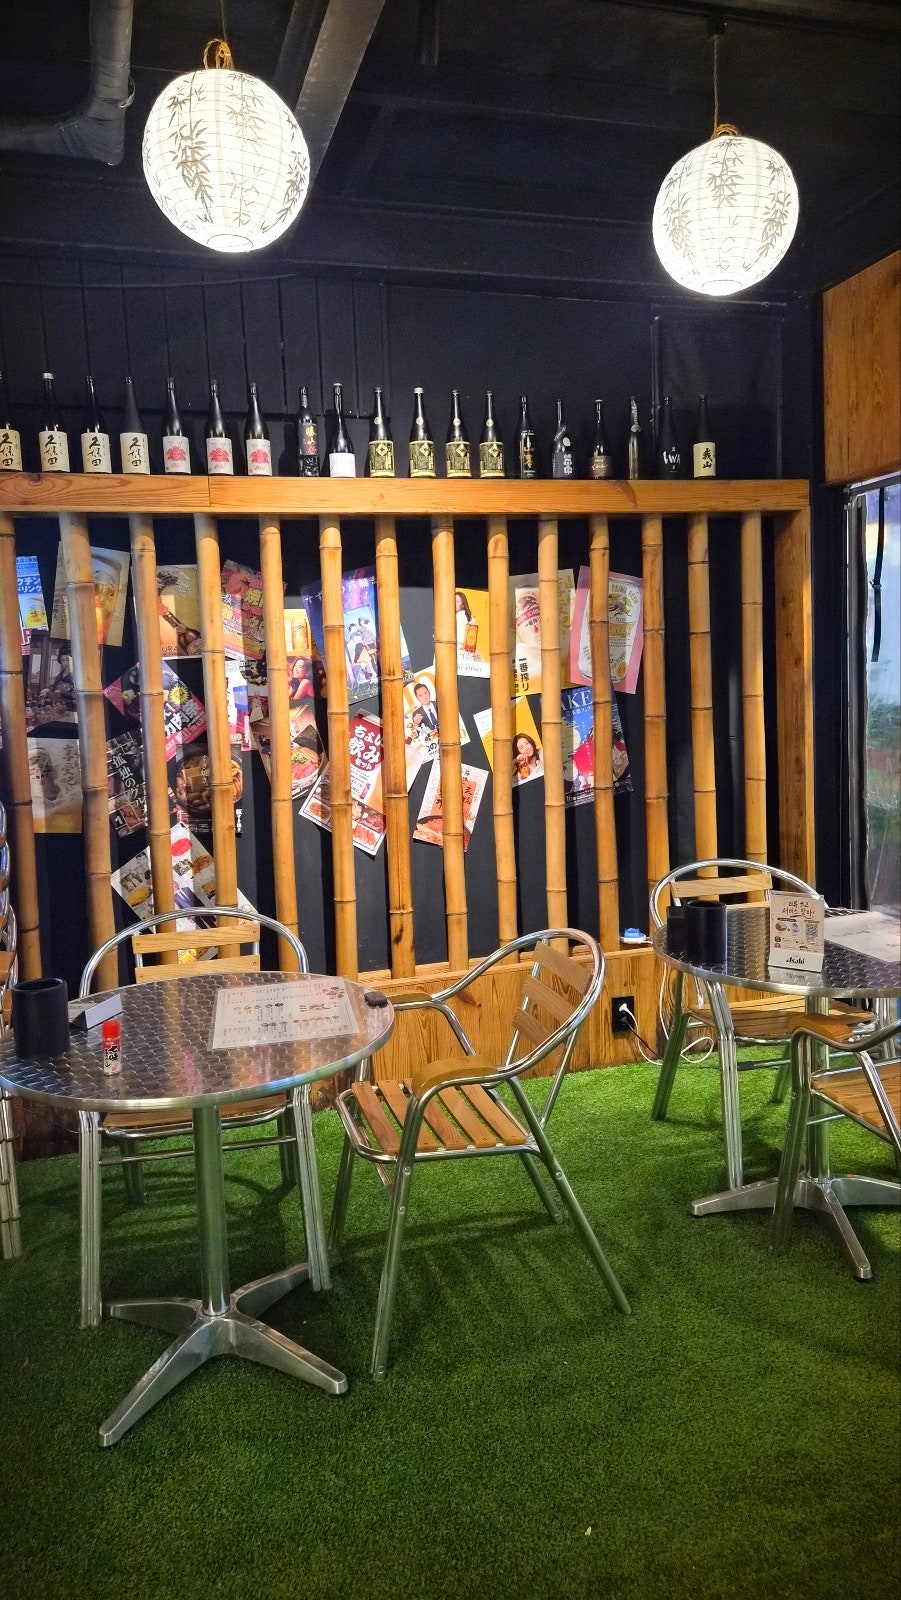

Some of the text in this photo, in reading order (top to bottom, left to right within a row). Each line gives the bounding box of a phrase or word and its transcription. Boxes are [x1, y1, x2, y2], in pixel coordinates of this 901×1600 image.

[44, 434, 58, 465] 久保田
[87, 436, 102, 467] 久保田
[127, 436, 141, 467] 久保田
[518, 657, 530, 692] 一番搾り
[786, 956, 805, 965] Asahi
